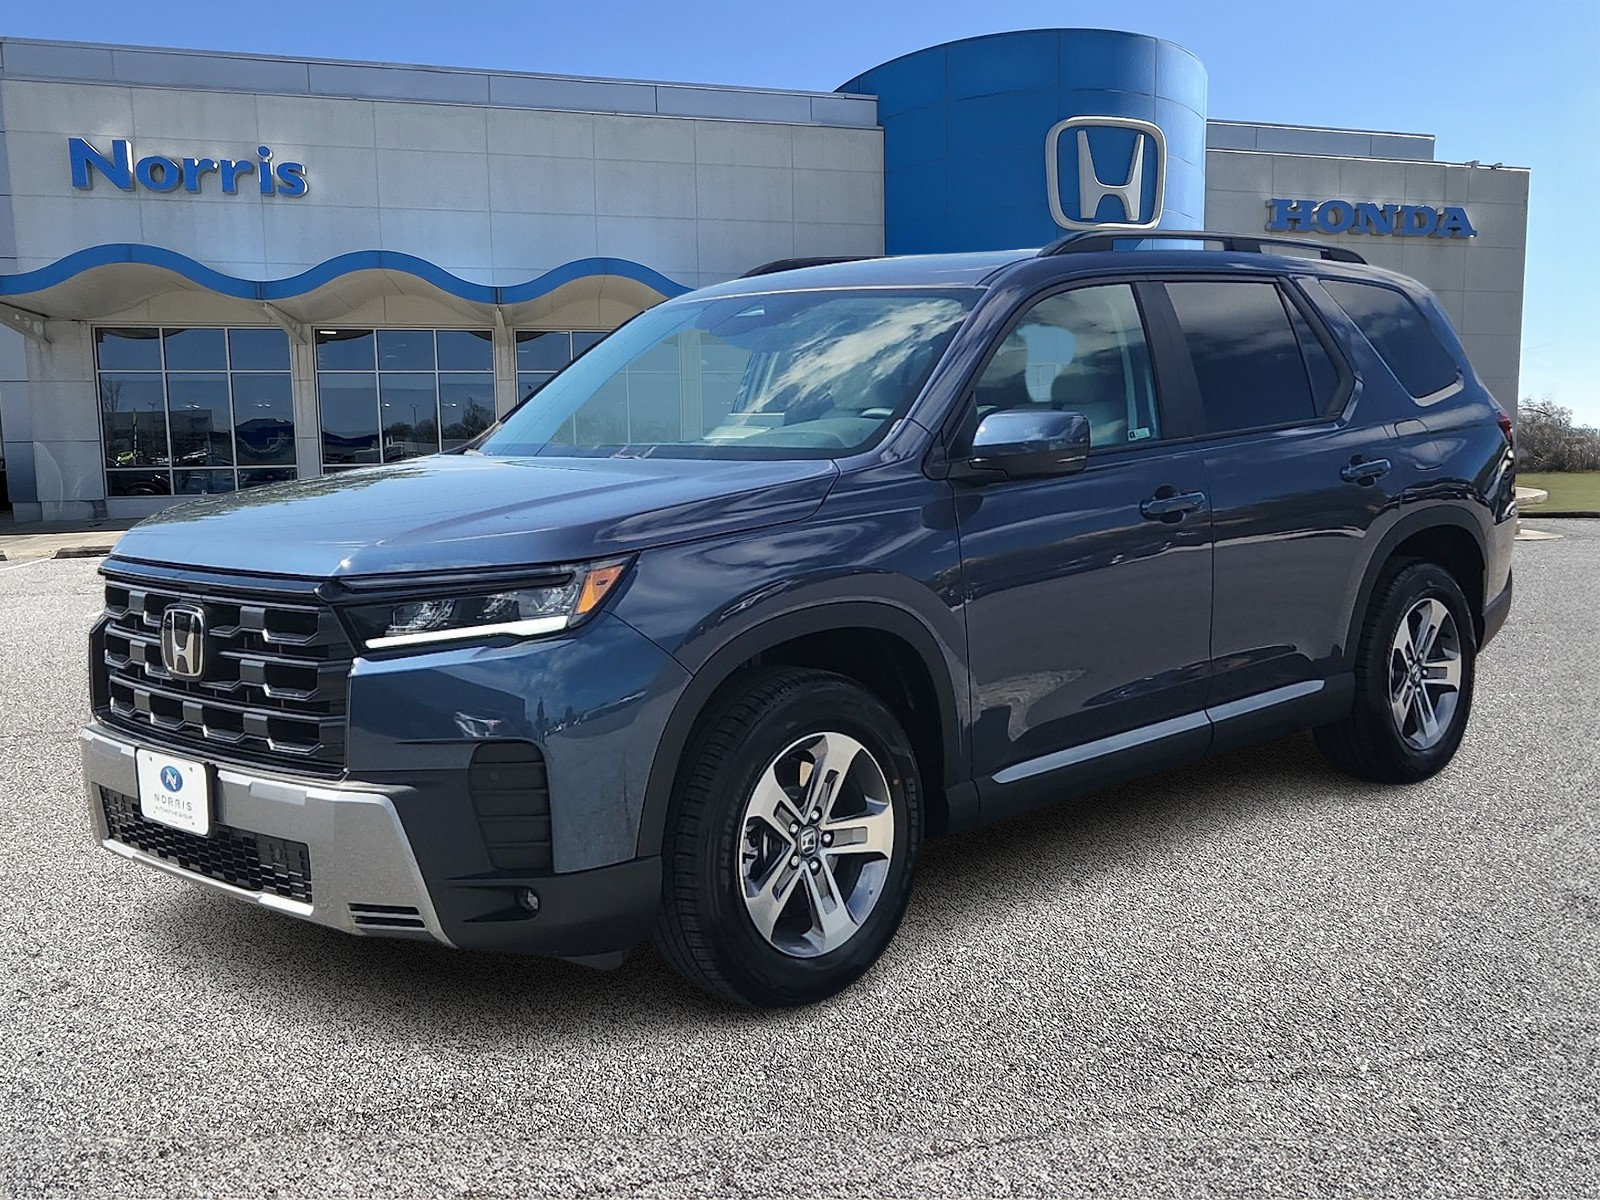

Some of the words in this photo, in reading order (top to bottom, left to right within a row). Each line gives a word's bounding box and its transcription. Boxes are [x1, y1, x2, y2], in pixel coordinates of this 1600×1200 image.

[68, 137, 309, 197] Norris
[1266, 198, 1478, 238] HONDA
[154, 793, 193, 812] NORRIS
